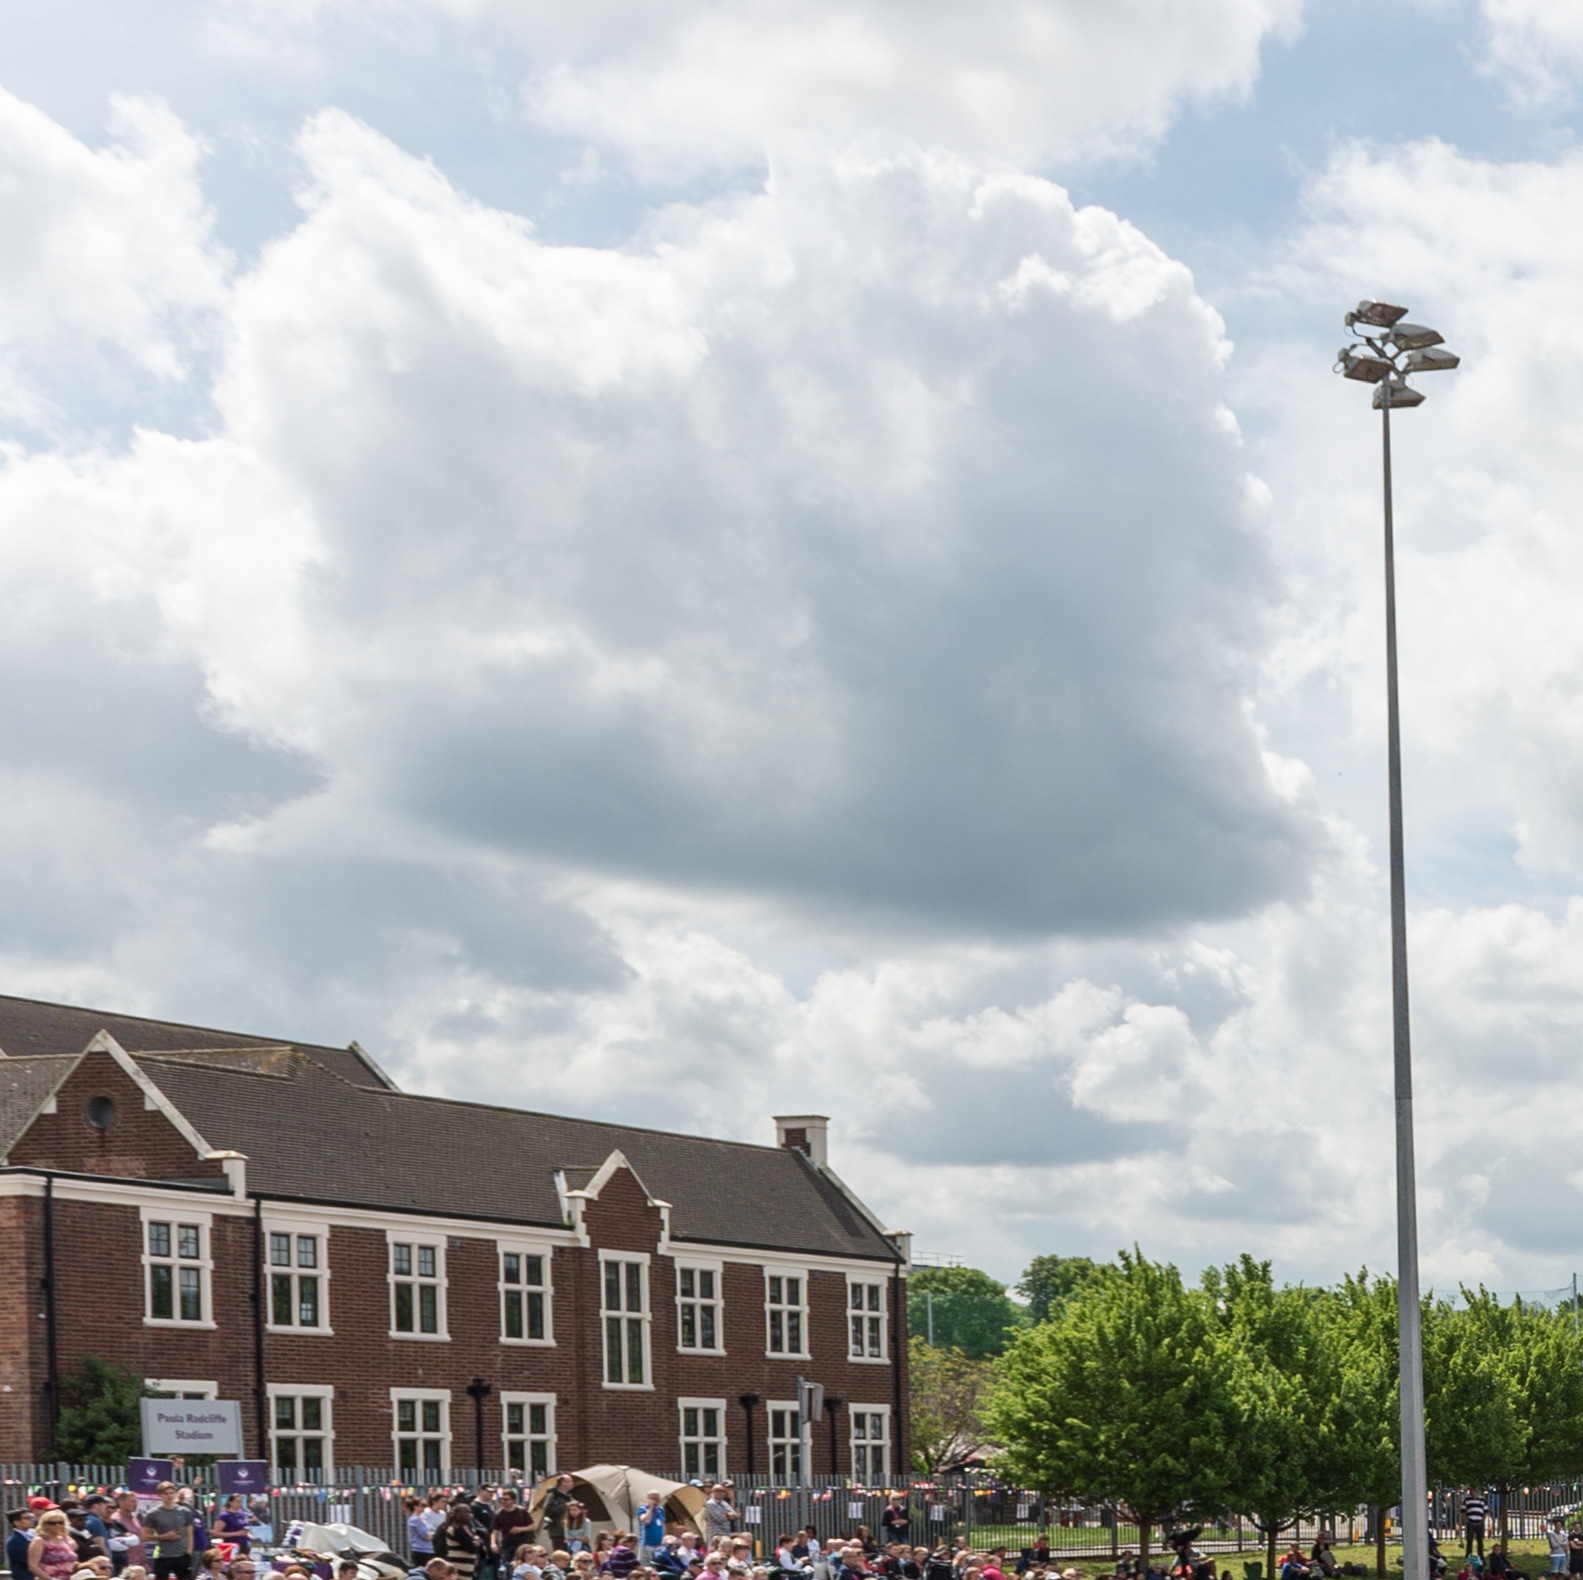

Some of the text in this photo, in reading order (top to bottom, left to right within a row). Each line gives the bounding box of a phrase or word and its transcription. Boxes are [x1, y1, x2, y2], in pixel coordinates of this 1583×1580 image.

[157, 1413, 227, 1424] Paula Radcliffe
[175, 1430, 213, 1439] Stadium
